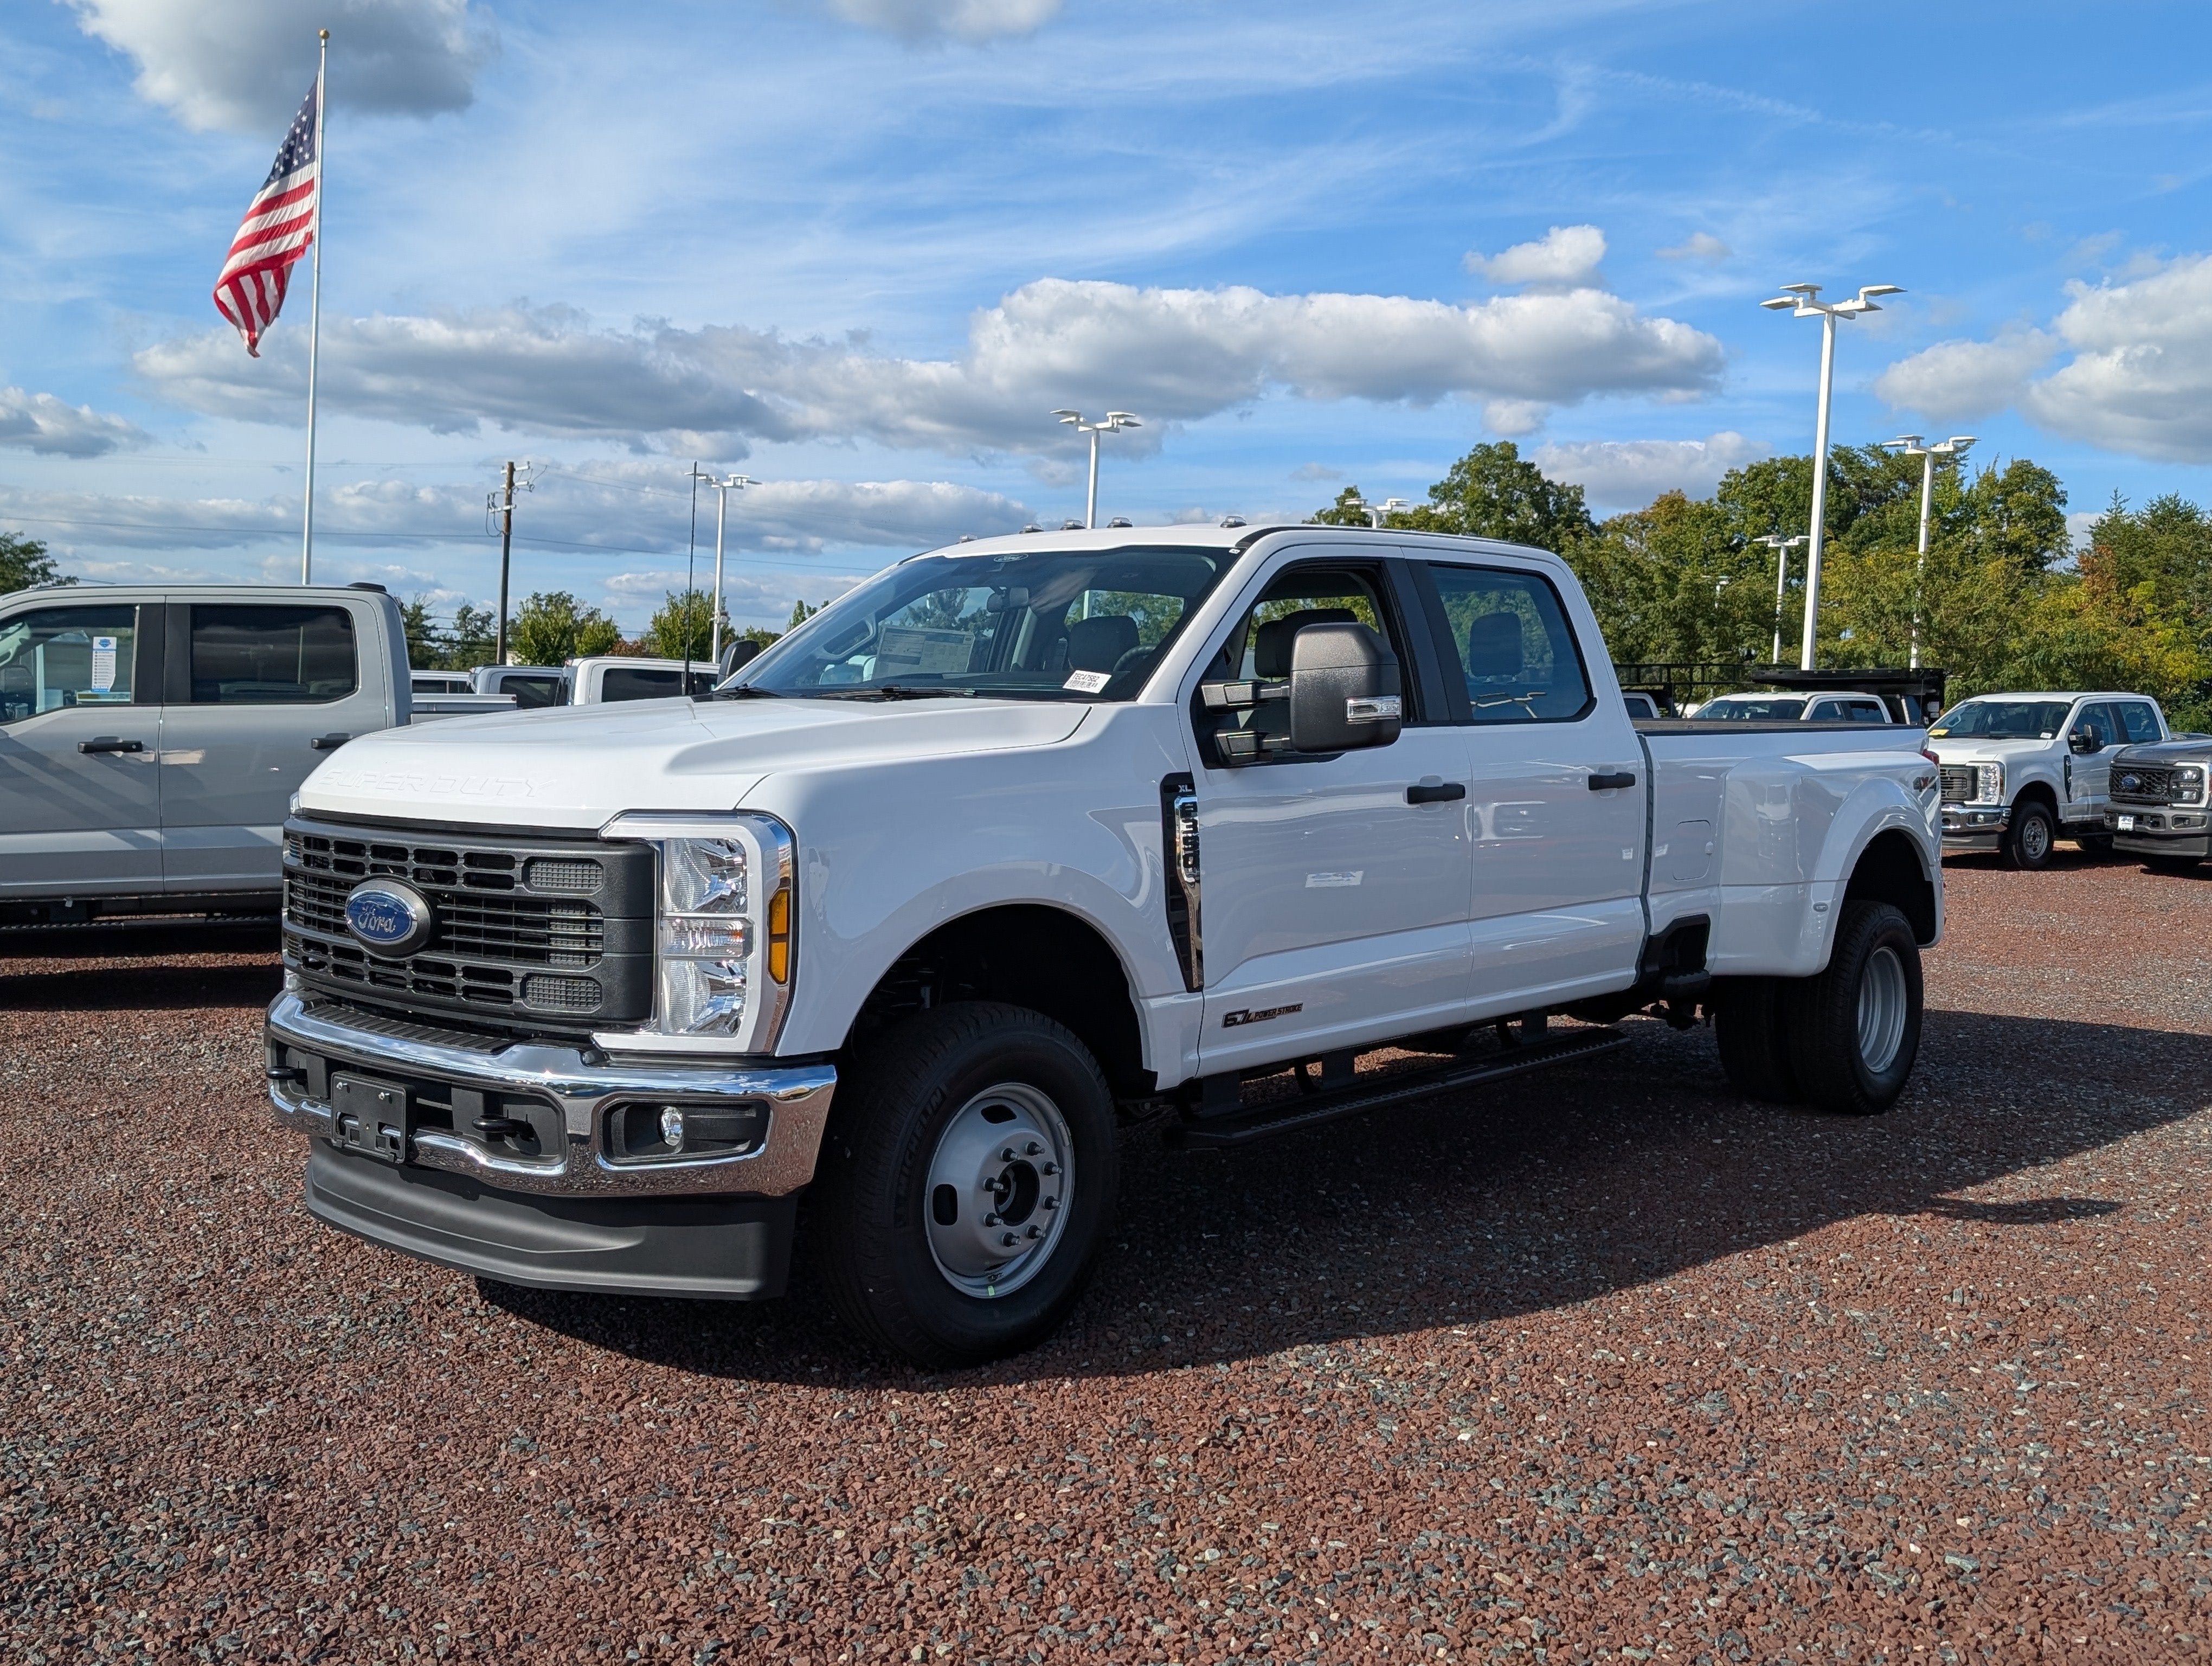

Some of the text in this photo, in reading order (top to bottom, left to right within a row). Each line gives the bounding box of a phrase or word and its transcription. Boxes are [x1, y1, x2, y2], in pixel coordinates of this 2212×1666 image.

[319, 768, 557, 797] SUPER DUTY
[1178, 784, 1193, 793] XL
[357, 905, 396, 933] Ford
[1254, 1009, 1276, 1019] POWER
[1277, 1004, 1302, 1015] STROKE
